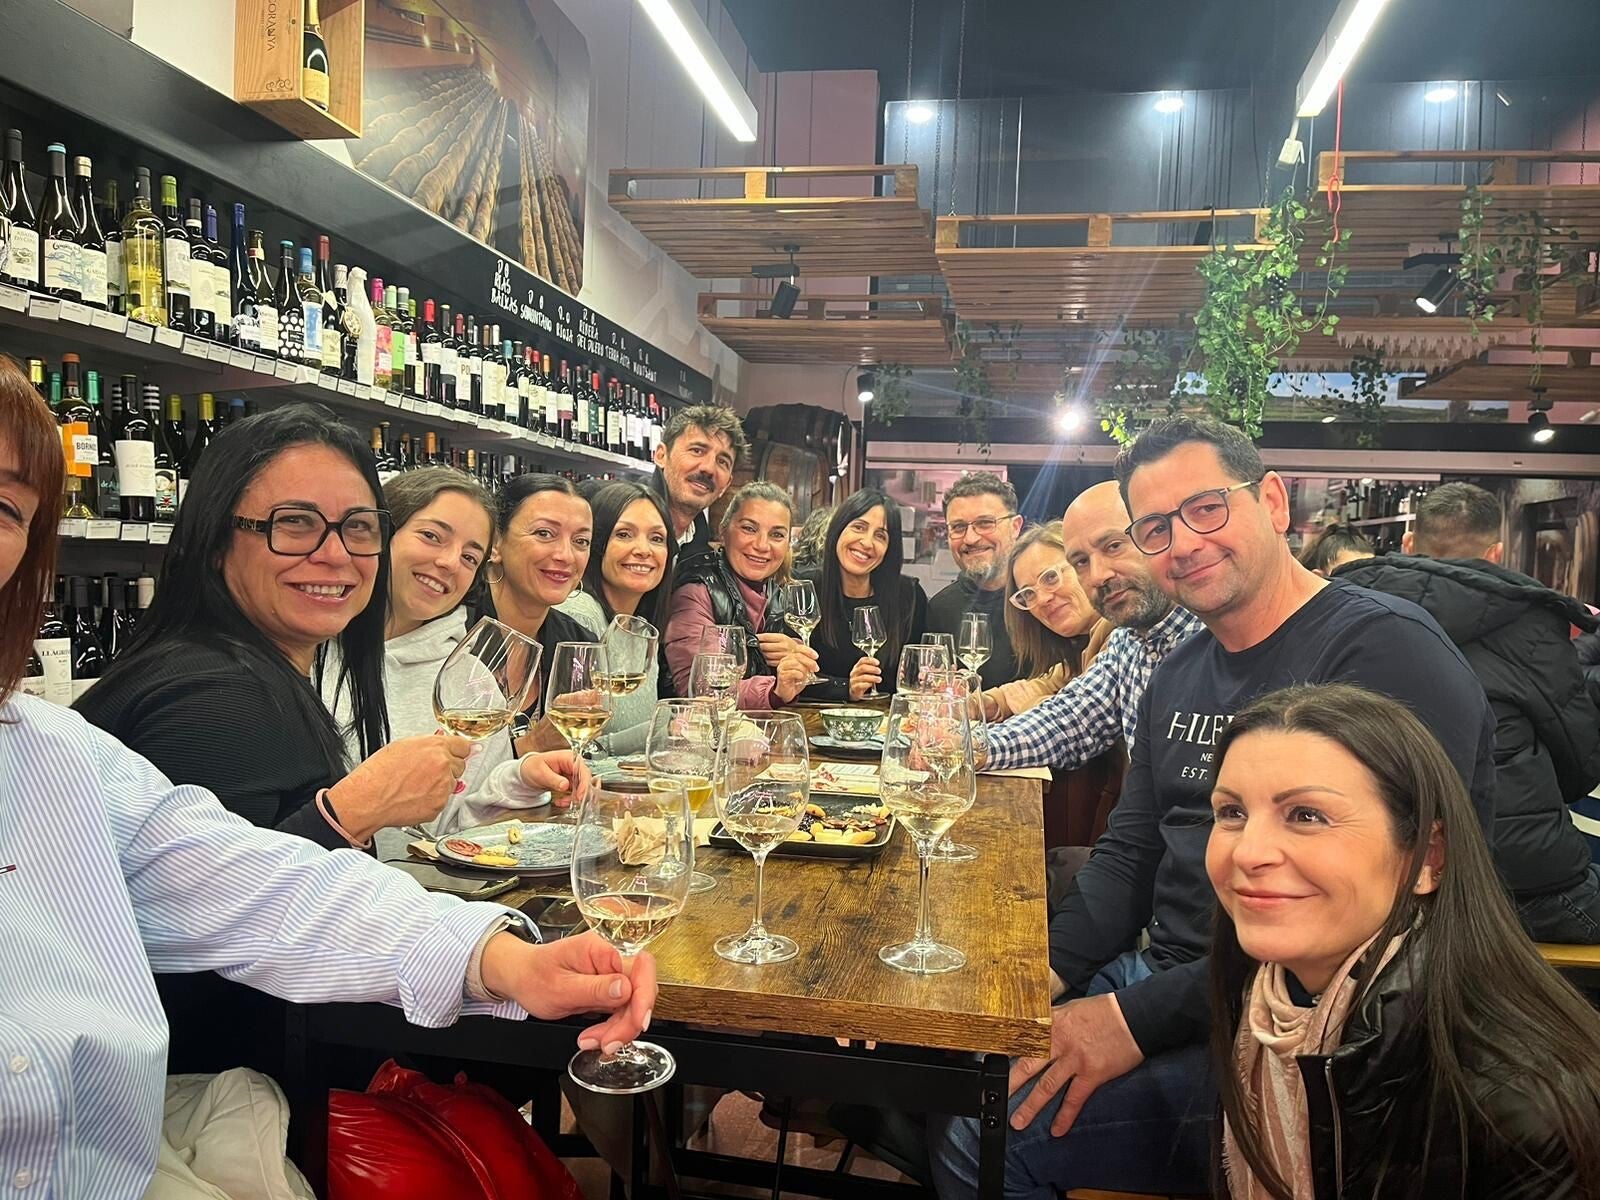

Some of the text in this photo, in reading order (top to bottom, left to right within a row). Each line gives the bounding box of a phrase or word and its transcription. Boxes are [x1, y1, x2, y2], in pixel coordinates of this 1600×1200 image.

[491, 287, 519, 315] BAIXAS
[520, 304, 553, 333] SOMONTANO
[578, 319, 599, 341] RIBERA
[556, 322, 574, 344] RIOJA
[576, 334, 604, 357] DEL DUERO
[1167, 711, 1235, 746] HILF
[1181, 766, 1208, 780] EST.
